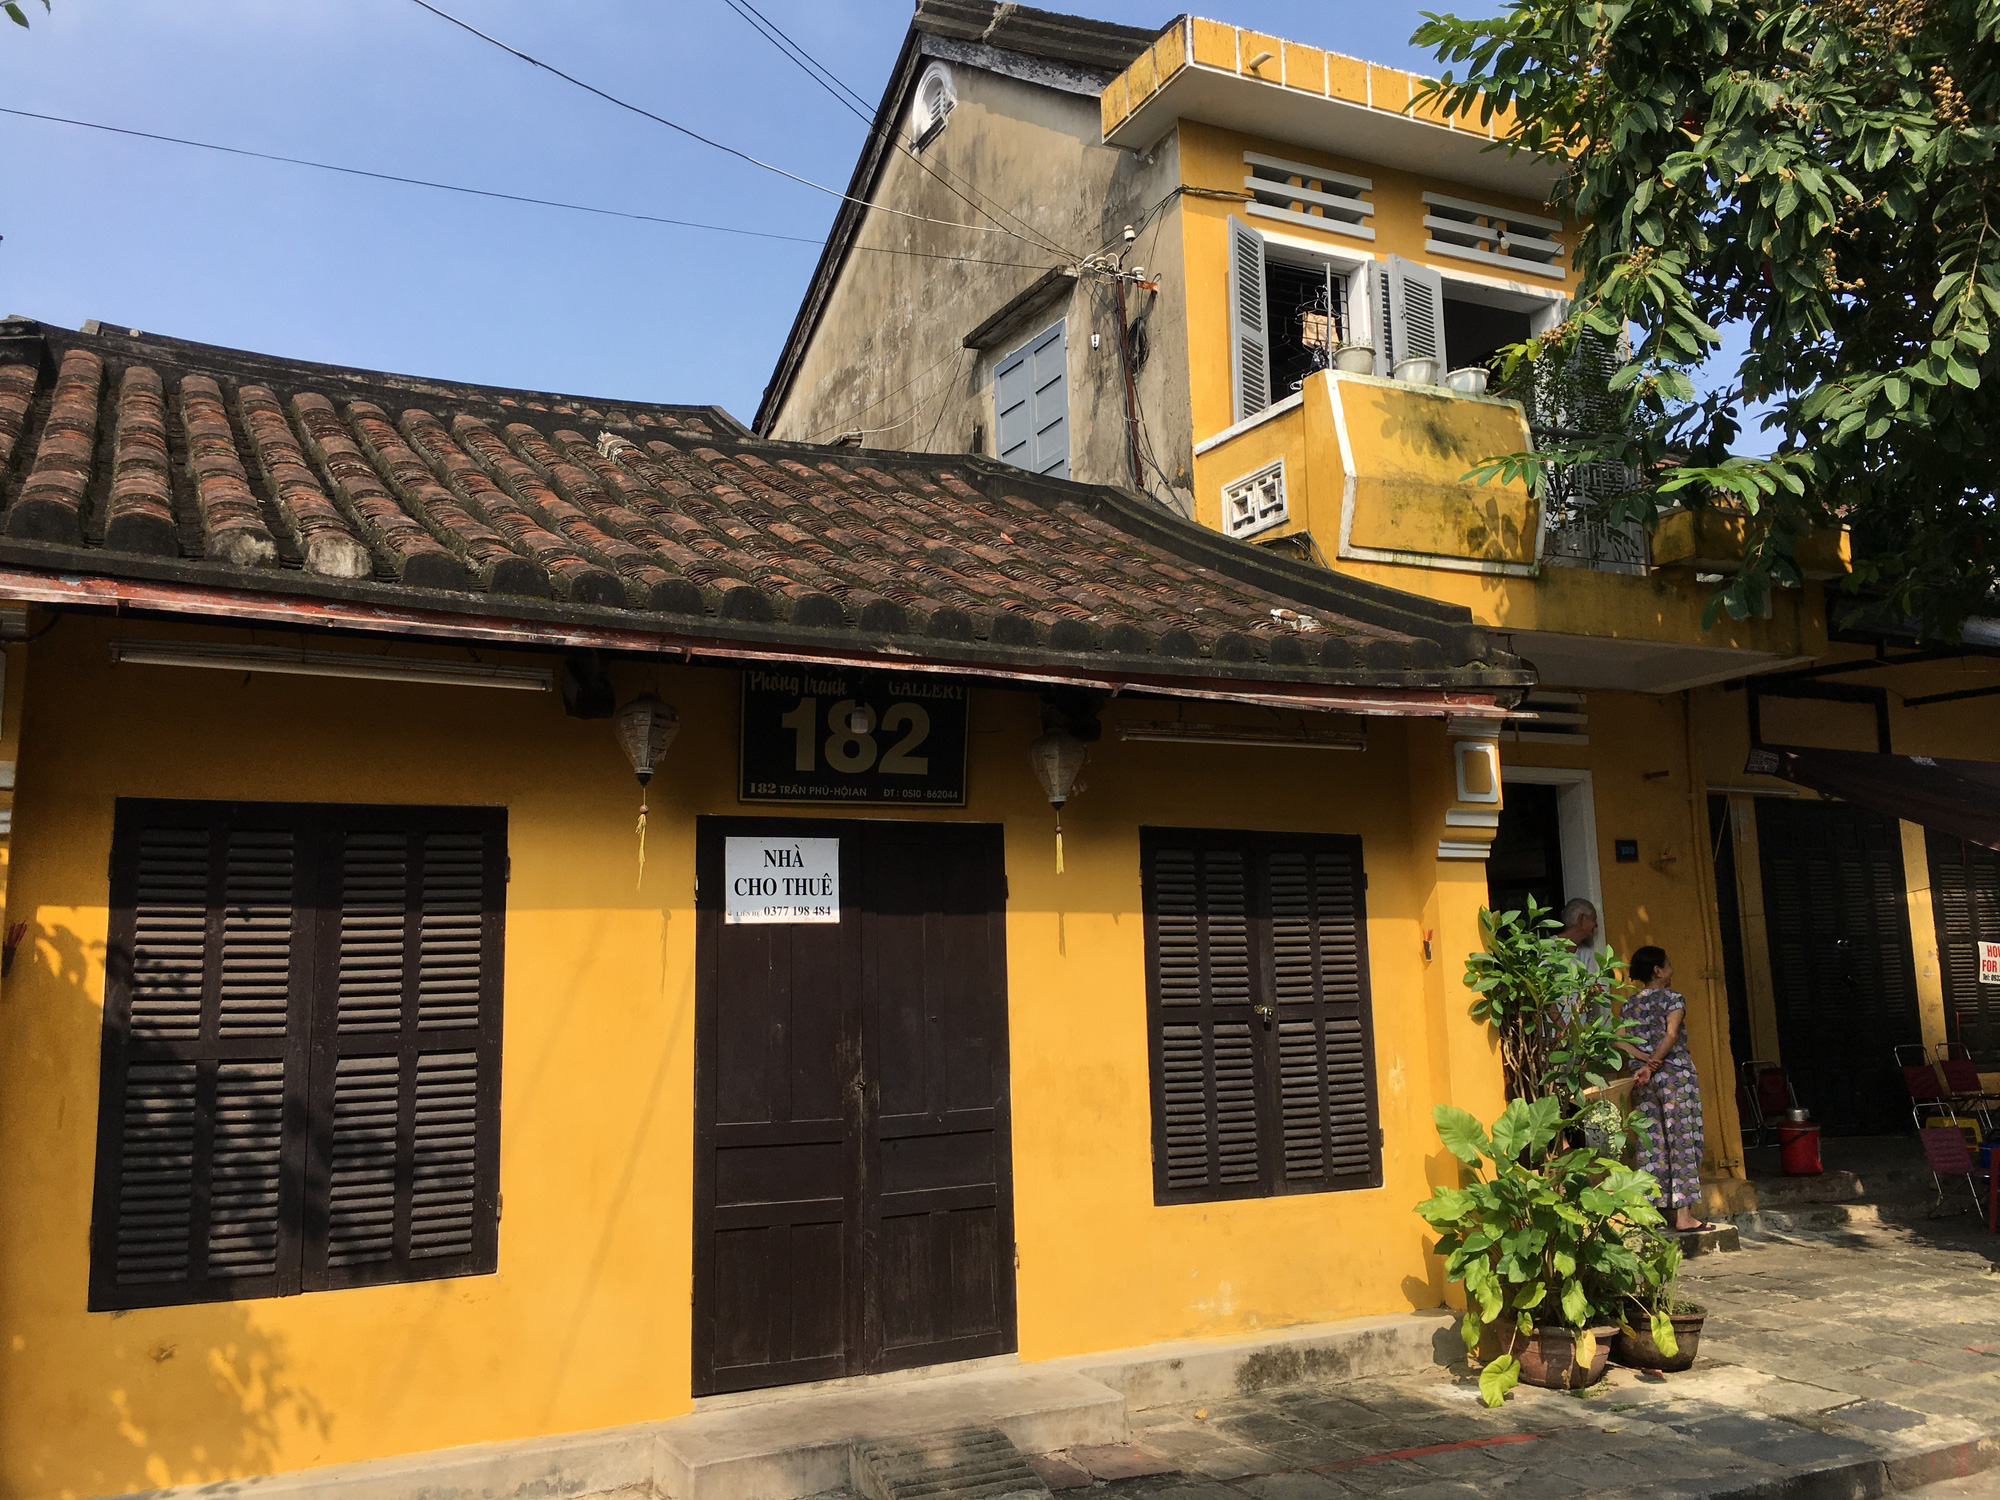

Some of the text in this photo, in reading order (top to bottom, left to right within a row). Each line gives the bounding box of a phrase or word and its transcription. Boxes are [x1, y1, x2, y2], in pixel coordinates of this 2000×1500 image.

[888, 680, 964, 701] GALLERY
[781, 697, 931, 775] 182
[749, 782, 777, 794] 182
[763, 844, 804, 868] NHÀ
[734, 872, 833, 897] CHO THUÊ
[763, 906, 789, 916] 0377
[793, 906, 810, 916] 198
[813, 906, 831, 916] 484
[1982, 959, 1998, 972] FOR
